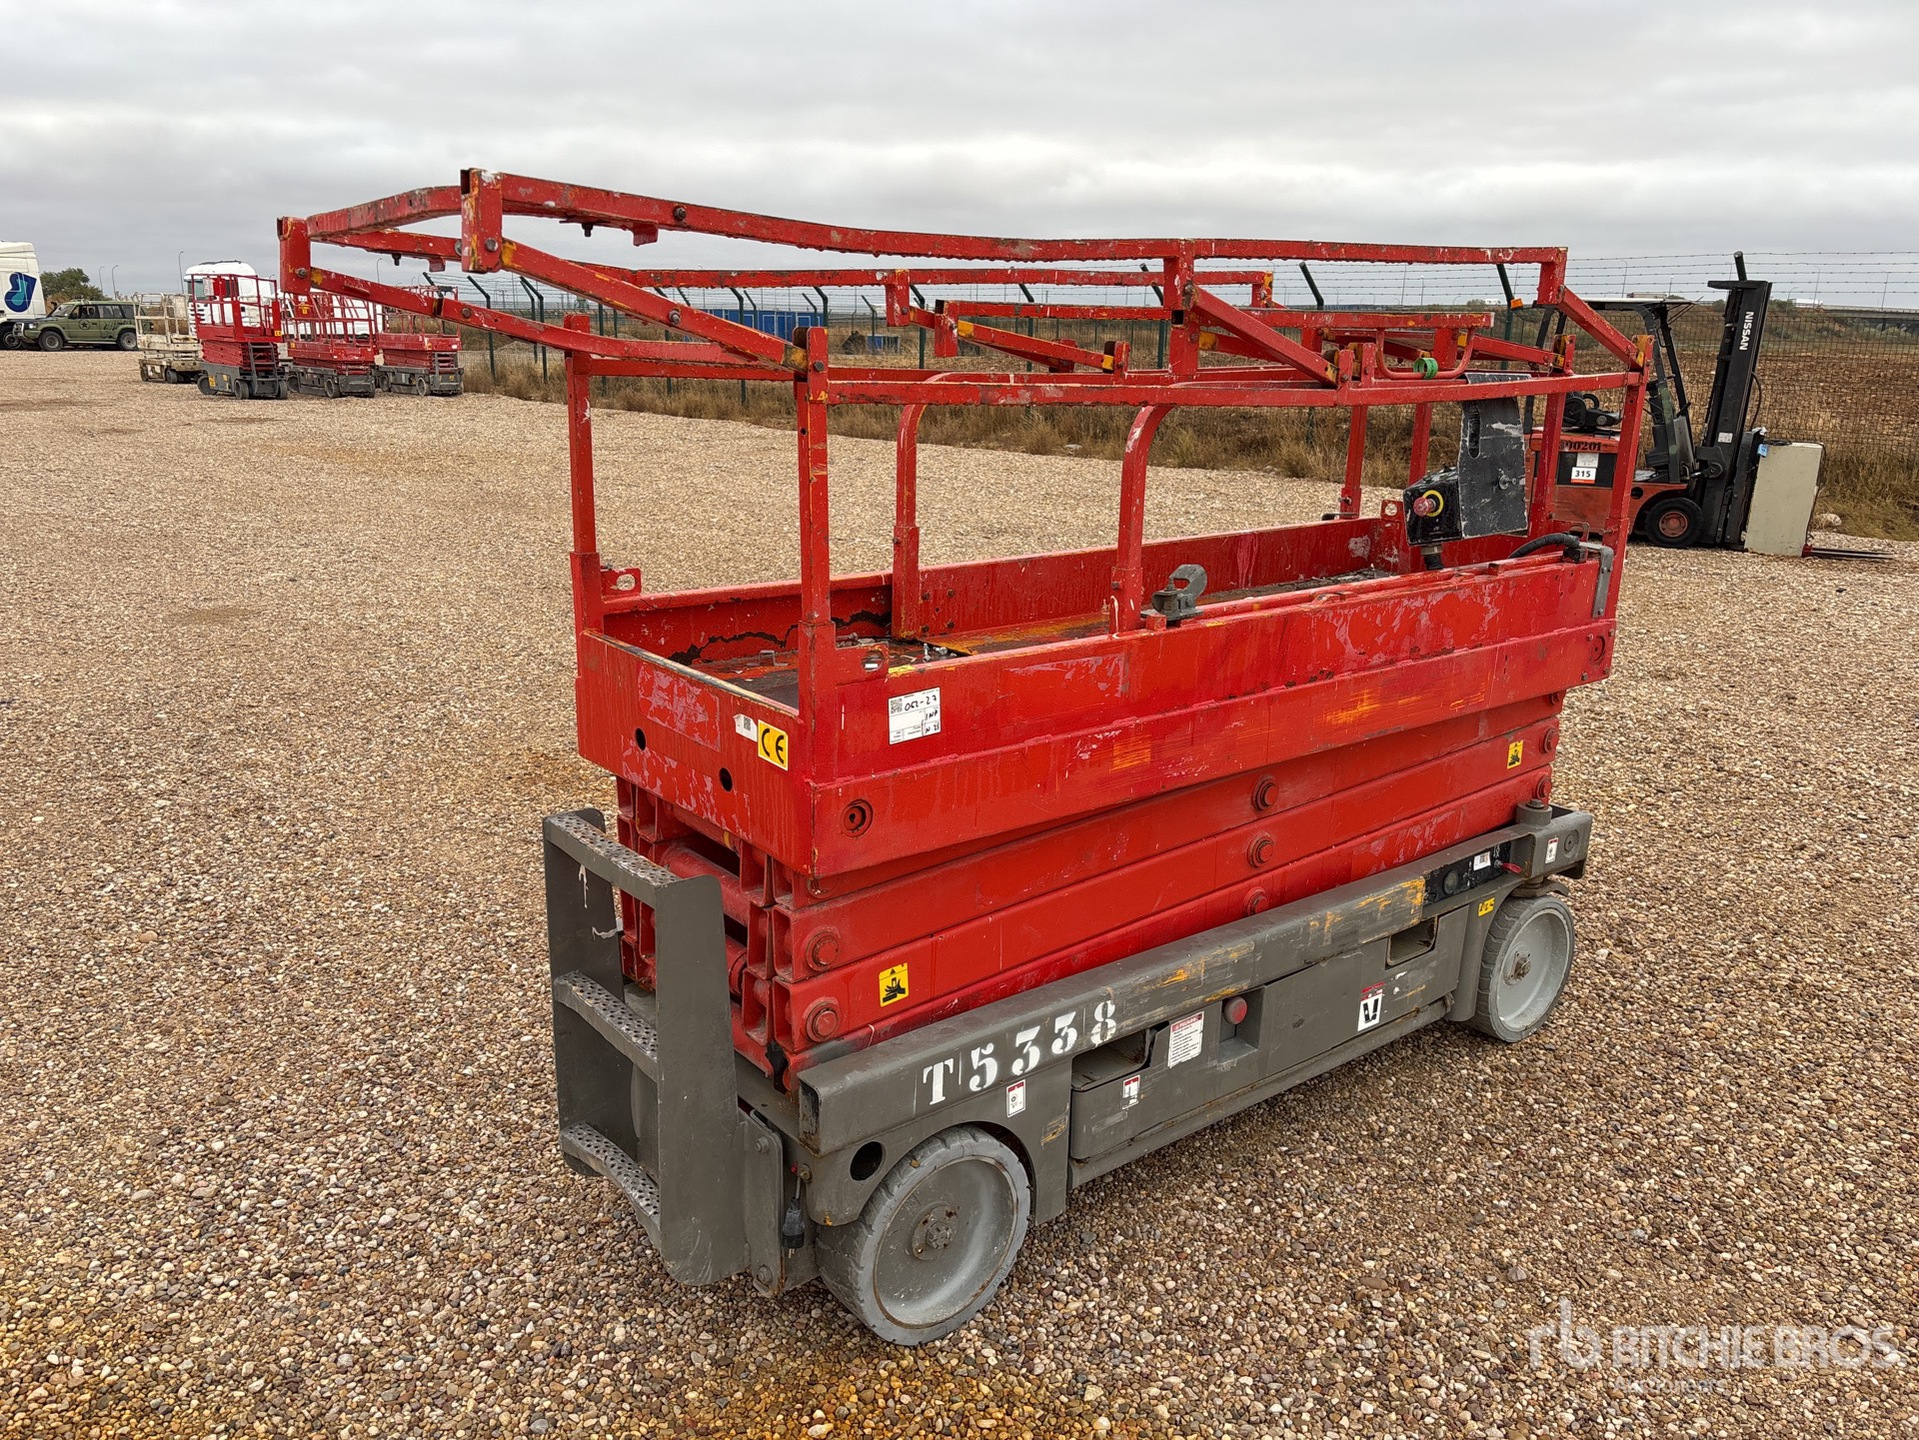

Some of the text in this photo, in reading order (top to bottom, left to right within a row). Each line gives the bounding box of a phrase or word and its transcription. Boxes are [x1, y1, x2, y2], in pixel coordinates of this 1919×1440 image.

[1739, 311, 1755, 351] NISSAN
[1574, 470, 1591, 478] 315
[761, 727, 785, 765] CE
[923, 999, 1117, 1105] T5338
